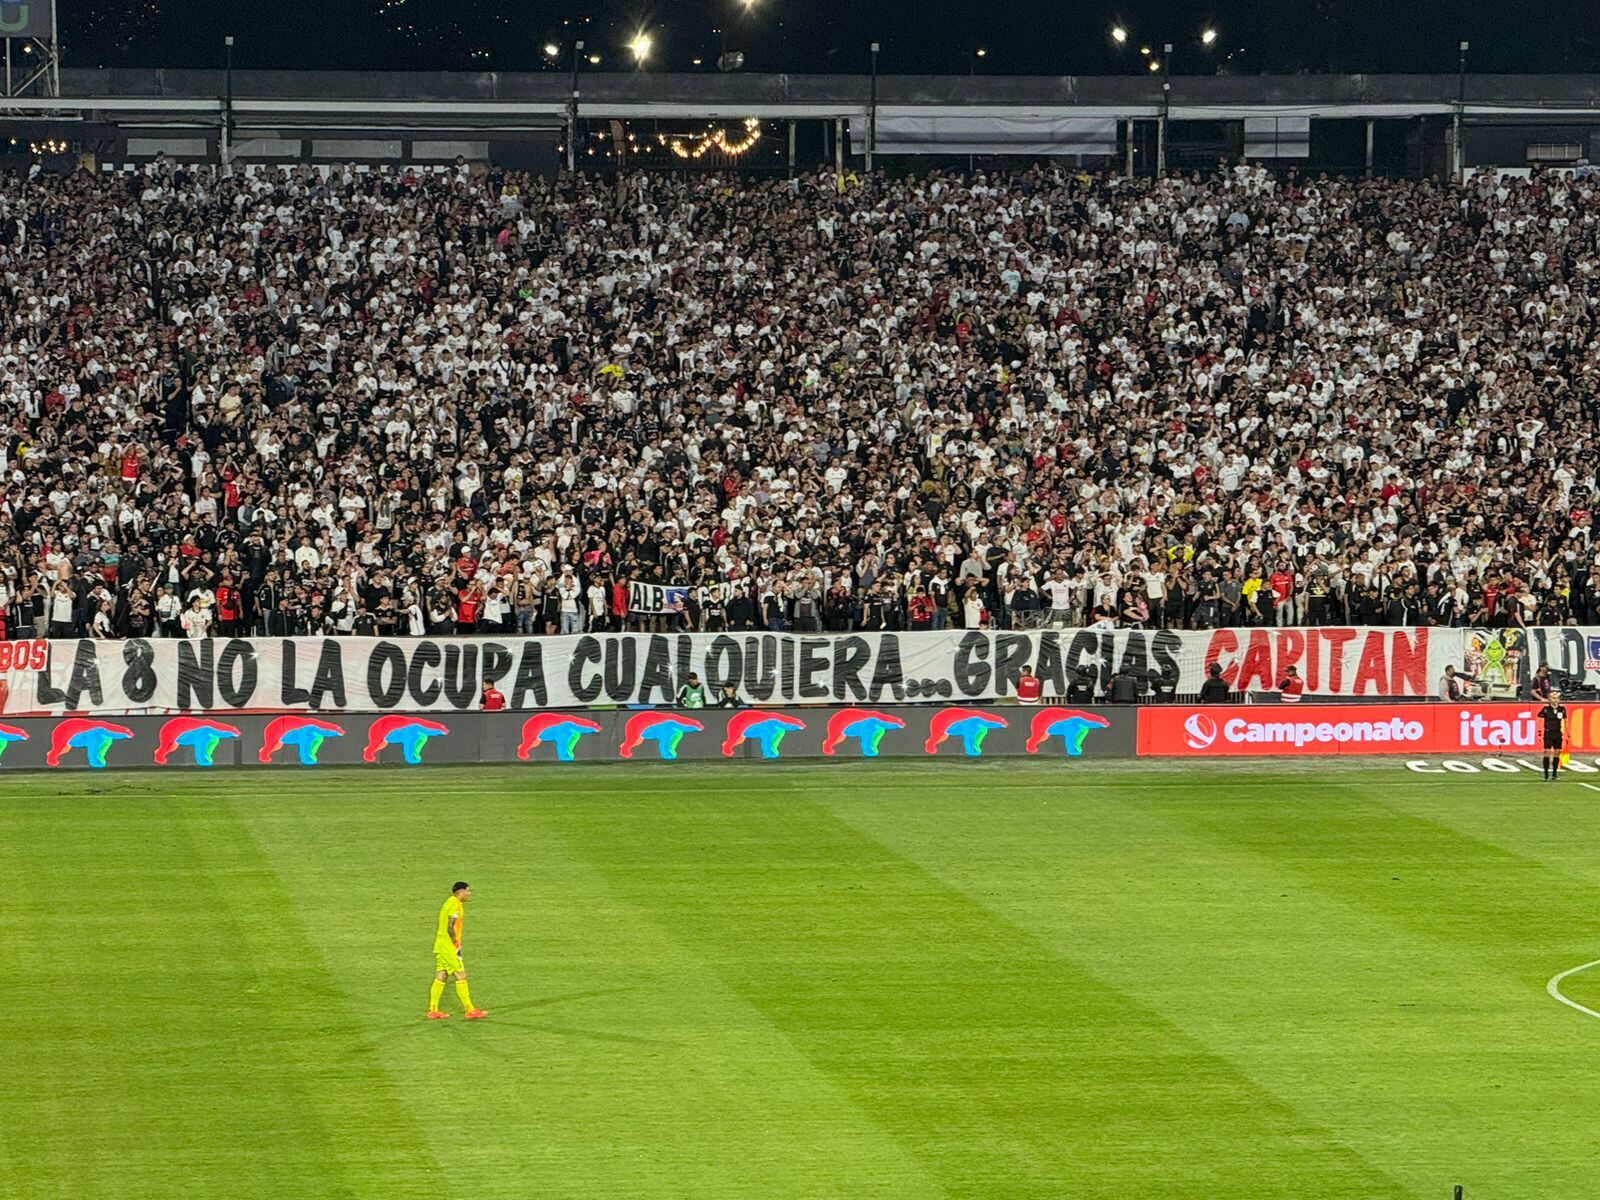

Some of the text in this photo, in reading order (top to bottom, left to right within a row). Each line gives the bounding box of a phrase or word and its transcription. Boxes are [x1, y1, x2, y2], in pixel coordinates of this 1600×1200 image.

[37, 639, 103, 710] LA
[122, 638, 157, 702] 8
[178, 638, 258, 709] NO
[282, 639, 347, 709] LA
[367, 640, 548, 709] OCUPA
[954, 629, 1183, 697] GRACIAS
[1205, 627, 1428, 697] CAPITAN
[1223, 717, 1424, 747] Campeonato
[1460, 710, 1536, 746] itaú
